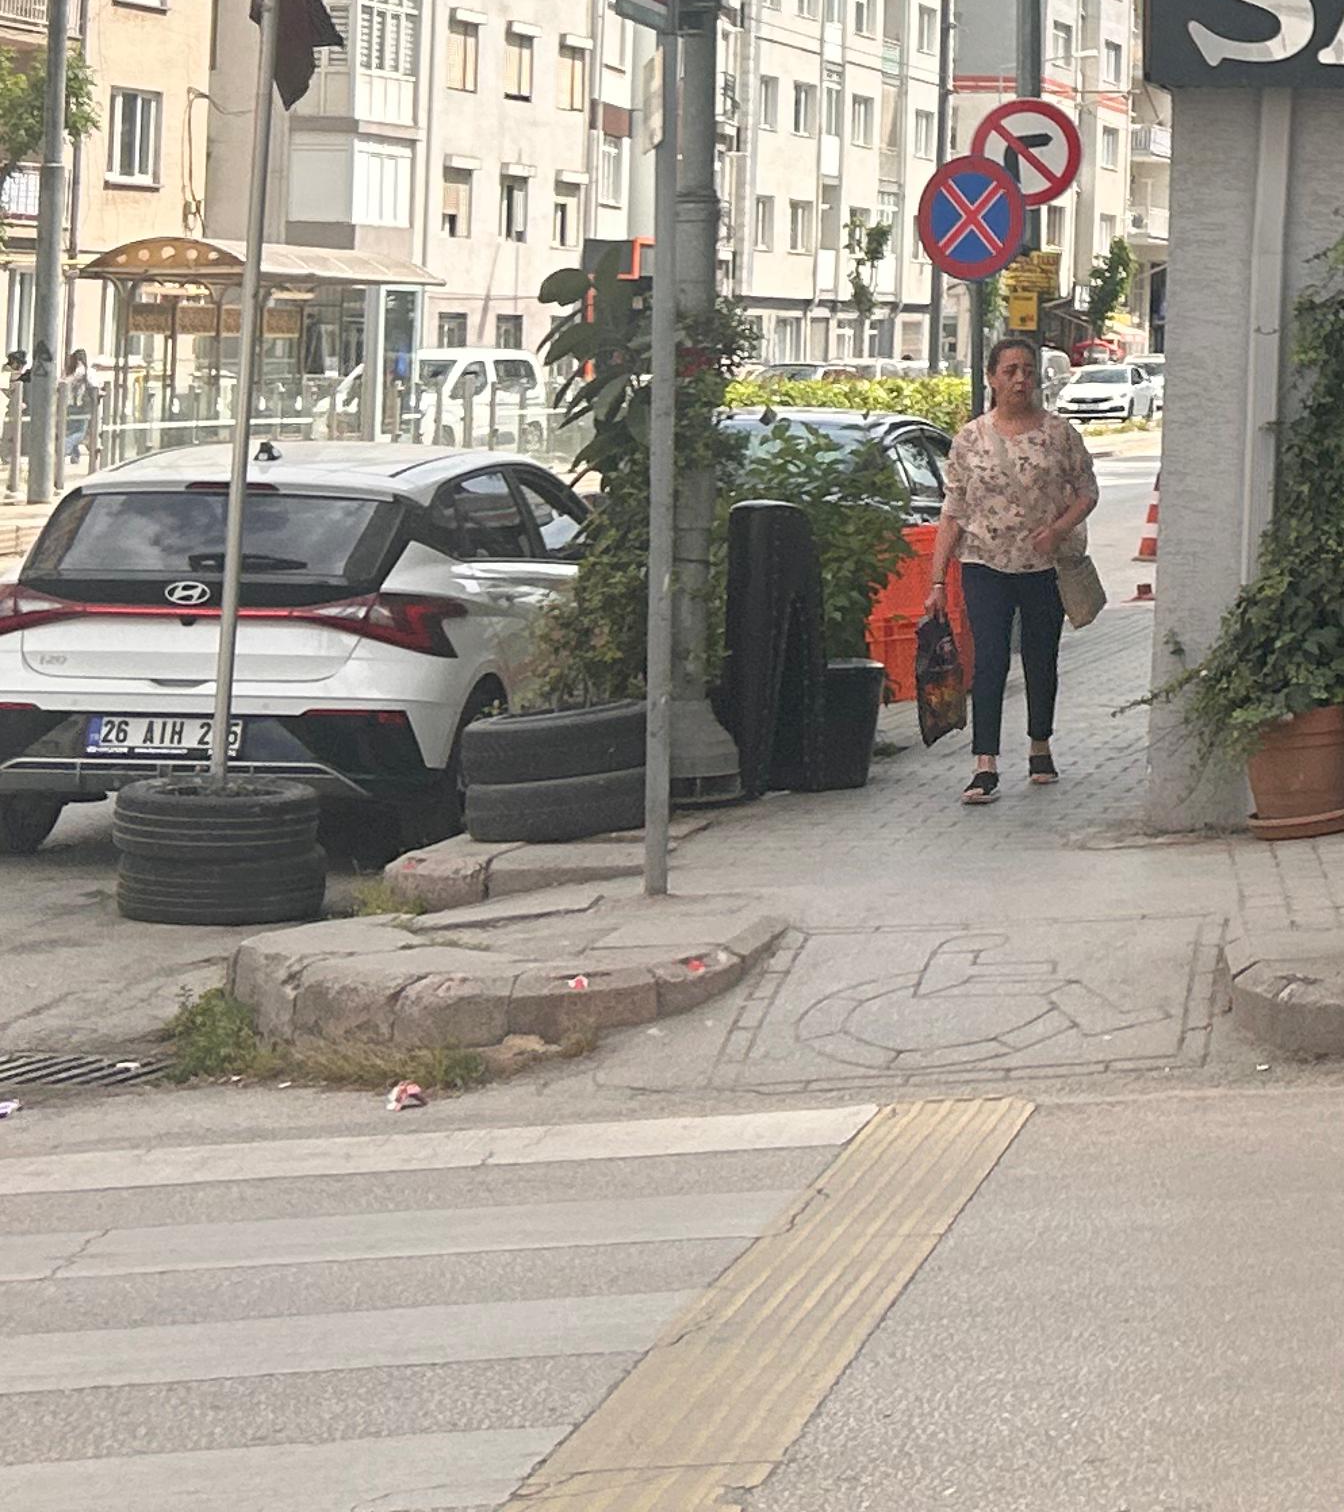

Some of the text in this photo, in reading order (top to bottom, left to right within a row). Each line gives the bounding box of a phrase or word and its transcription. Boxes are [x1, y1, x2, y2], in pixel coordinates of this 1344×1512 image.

[102, 720, 240, 746] 26 AIH 25
